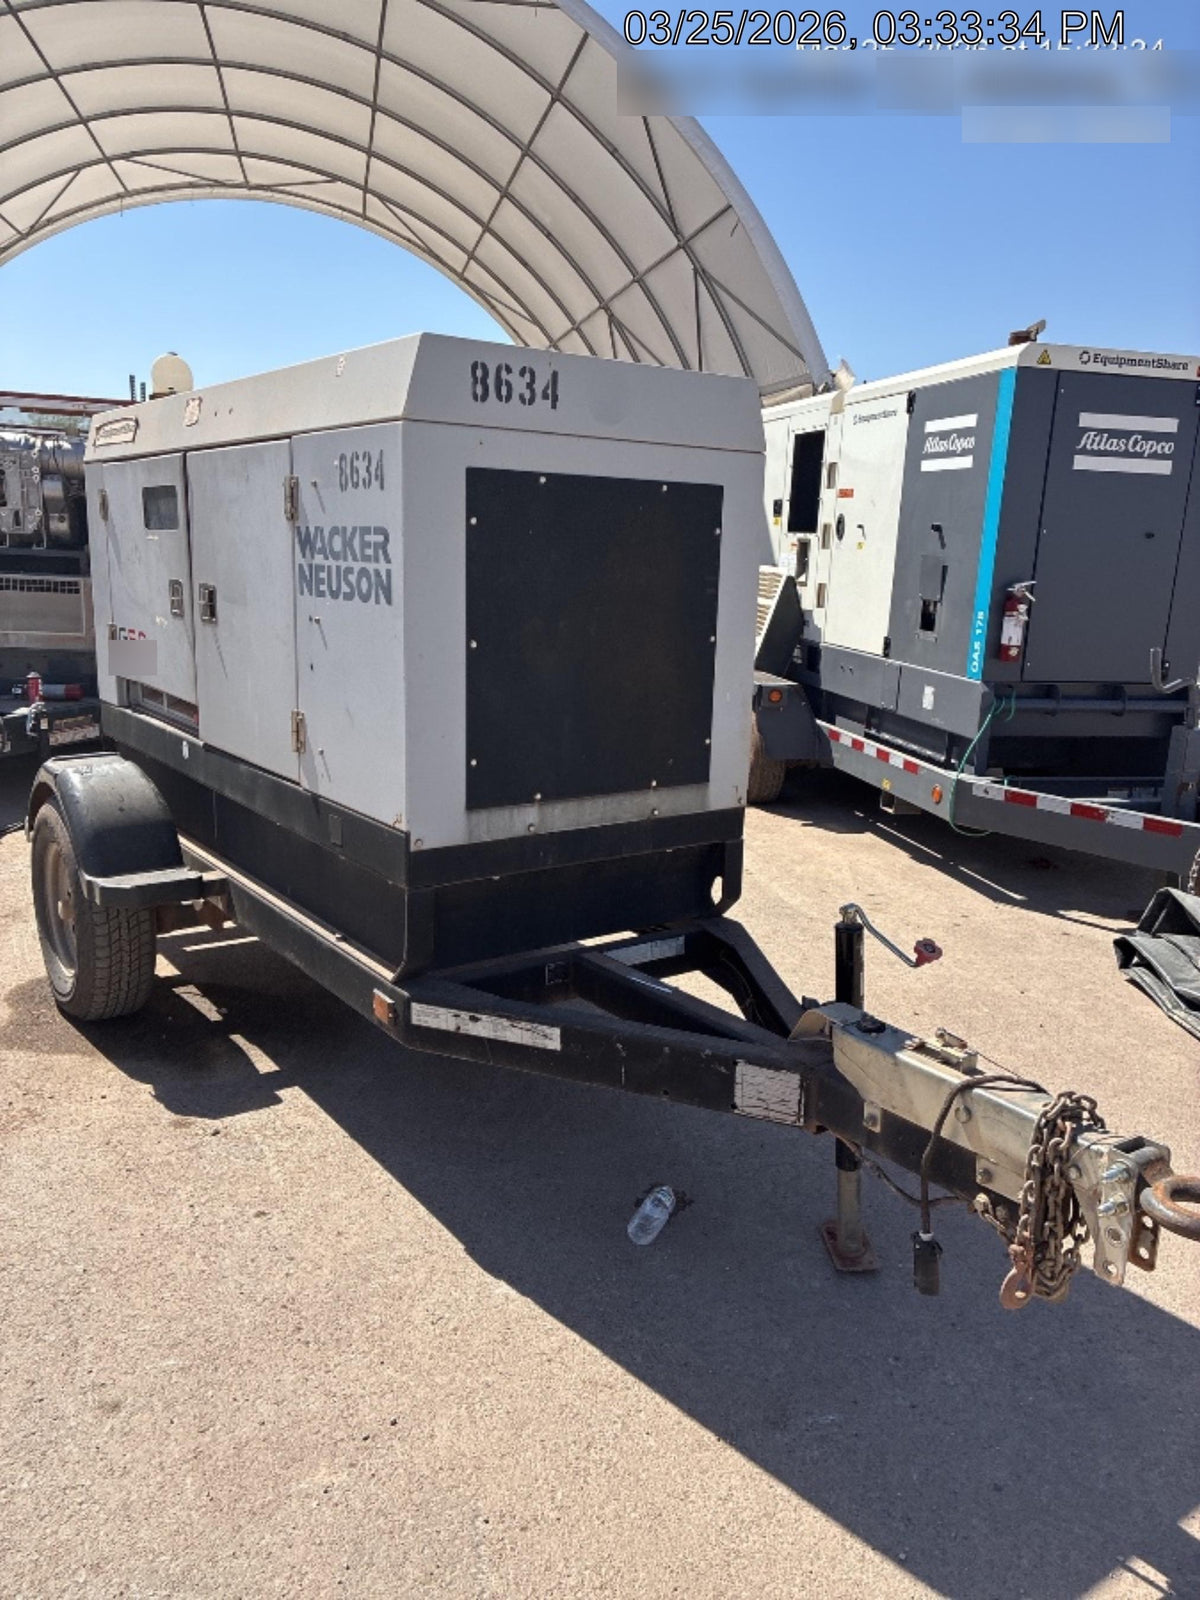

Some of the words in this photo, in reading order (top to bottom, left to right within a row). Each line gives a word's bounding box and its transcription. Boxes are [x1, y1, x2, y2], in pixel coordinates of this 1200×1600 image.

[1093, 353, 1189, 371] EquipmentShare
[470, 360, 560, 410] 8634
[1076, 430, 1127, 453] Atlas
[1126, 433, 1175, 458] Copco
[338, 449, 386, 492] 8634
[296, 526, 392, 564] WACKER
[298, 563, 393, 606] NEUSON
